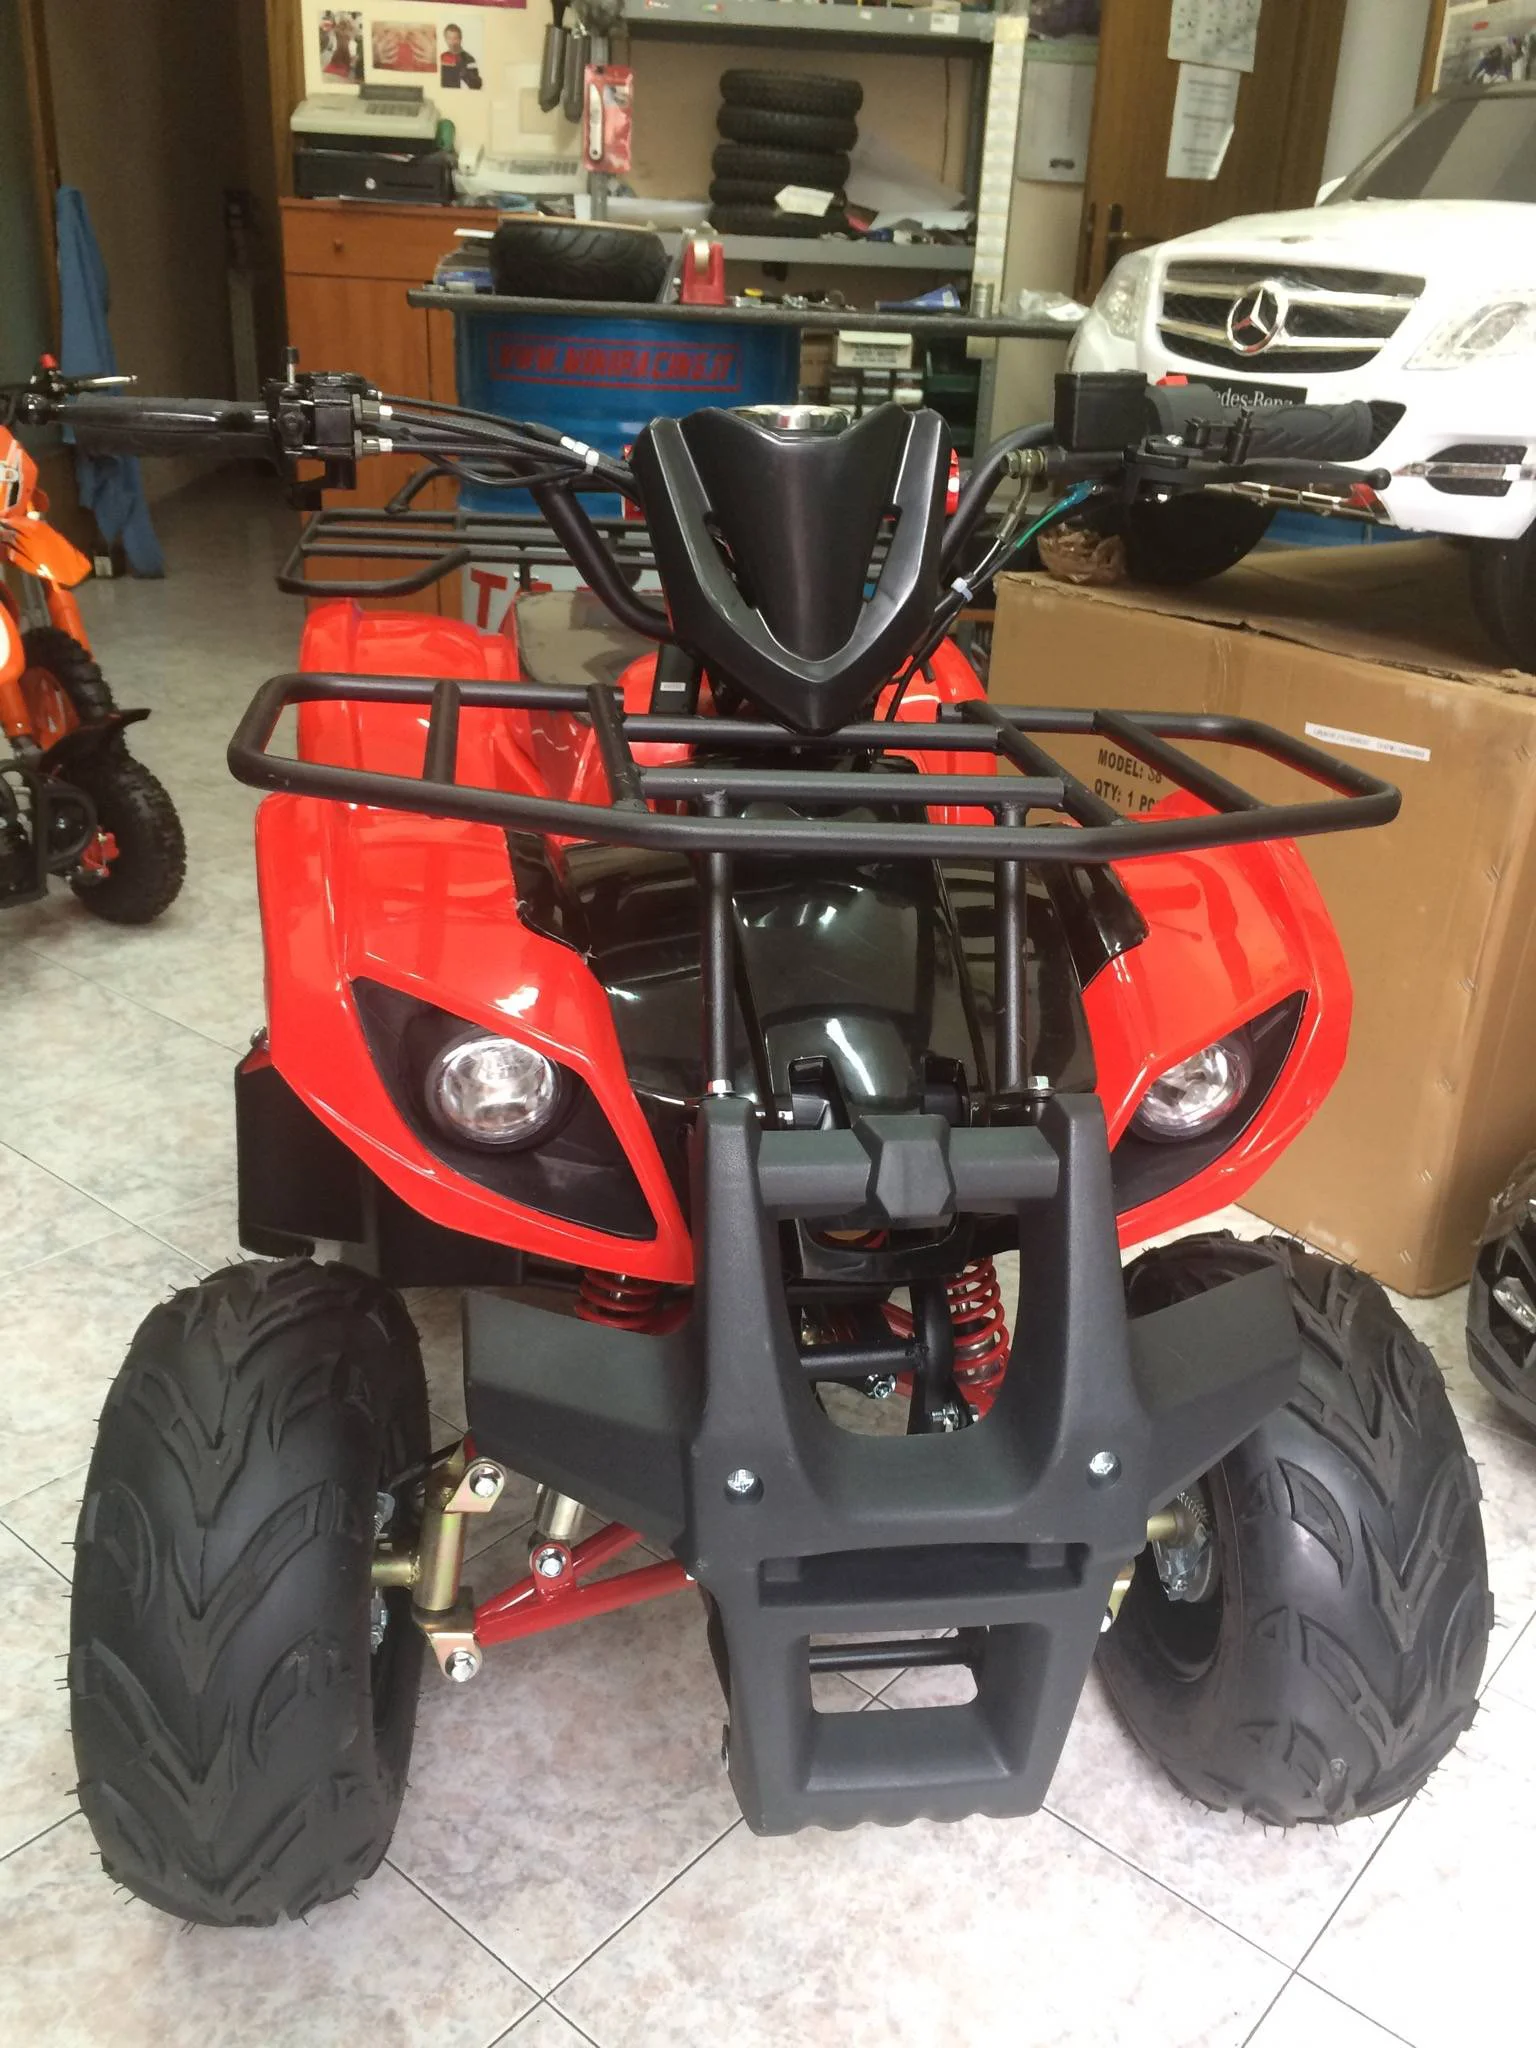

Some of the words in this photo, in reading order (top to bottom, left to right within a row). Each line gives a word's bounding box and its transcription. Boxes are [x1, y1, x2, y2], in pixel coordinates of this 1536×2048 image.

[1097, 748, 1144, 779] MODEL:
[1094, 778, 1122, 803] QTY:
[1127, 790, 1134, 808] 1
[1139, 794, 1159, 812] PC
